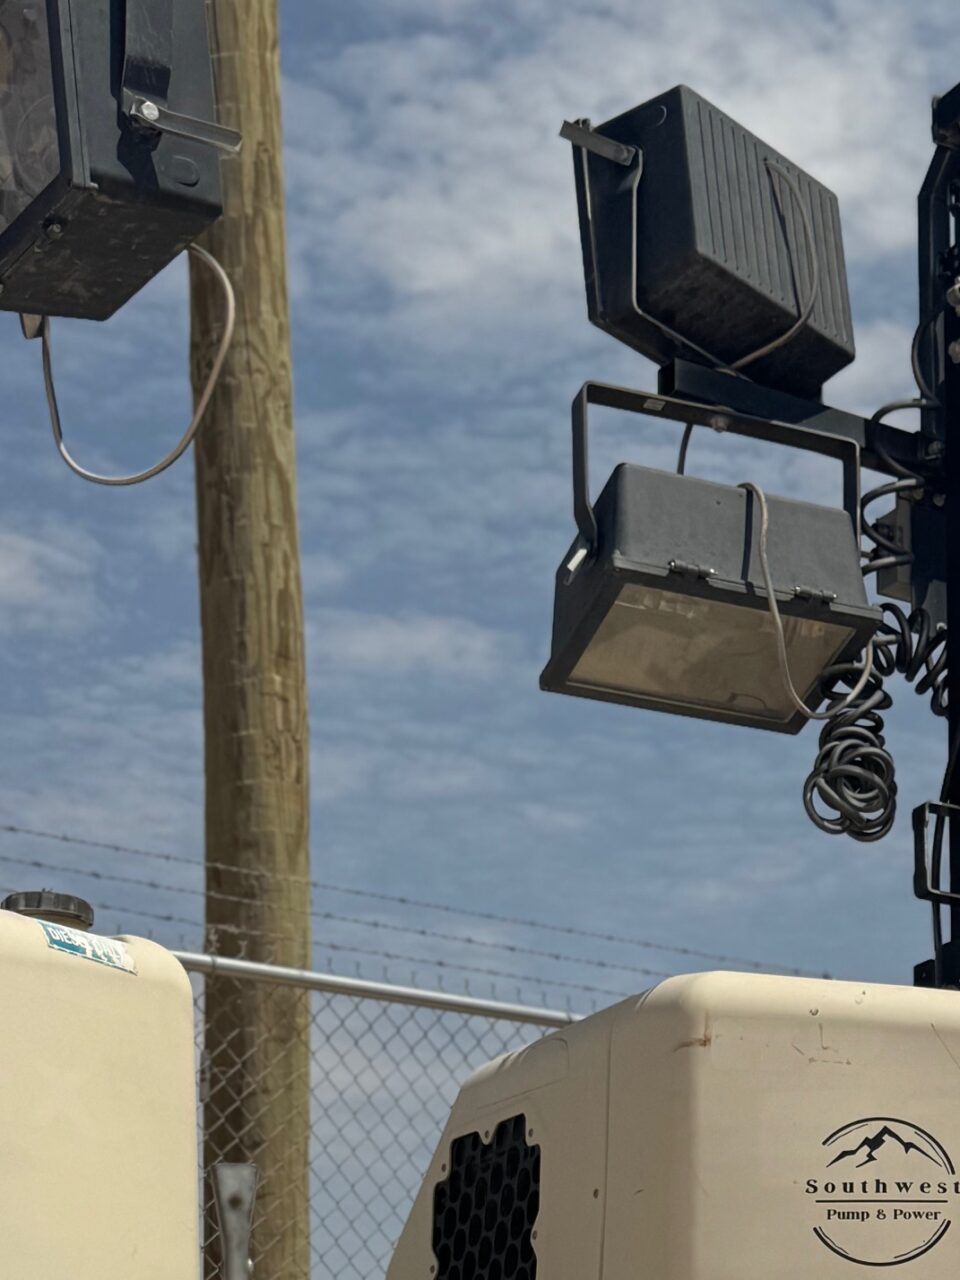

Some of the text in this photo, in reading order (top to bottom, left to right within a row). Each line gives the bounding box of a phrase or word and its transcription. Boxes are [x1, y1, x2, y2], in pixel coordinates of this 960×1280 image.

[804, 1178, 960, 1195] Southwest
[826, 1208, 942, 1222] Pump & Power
